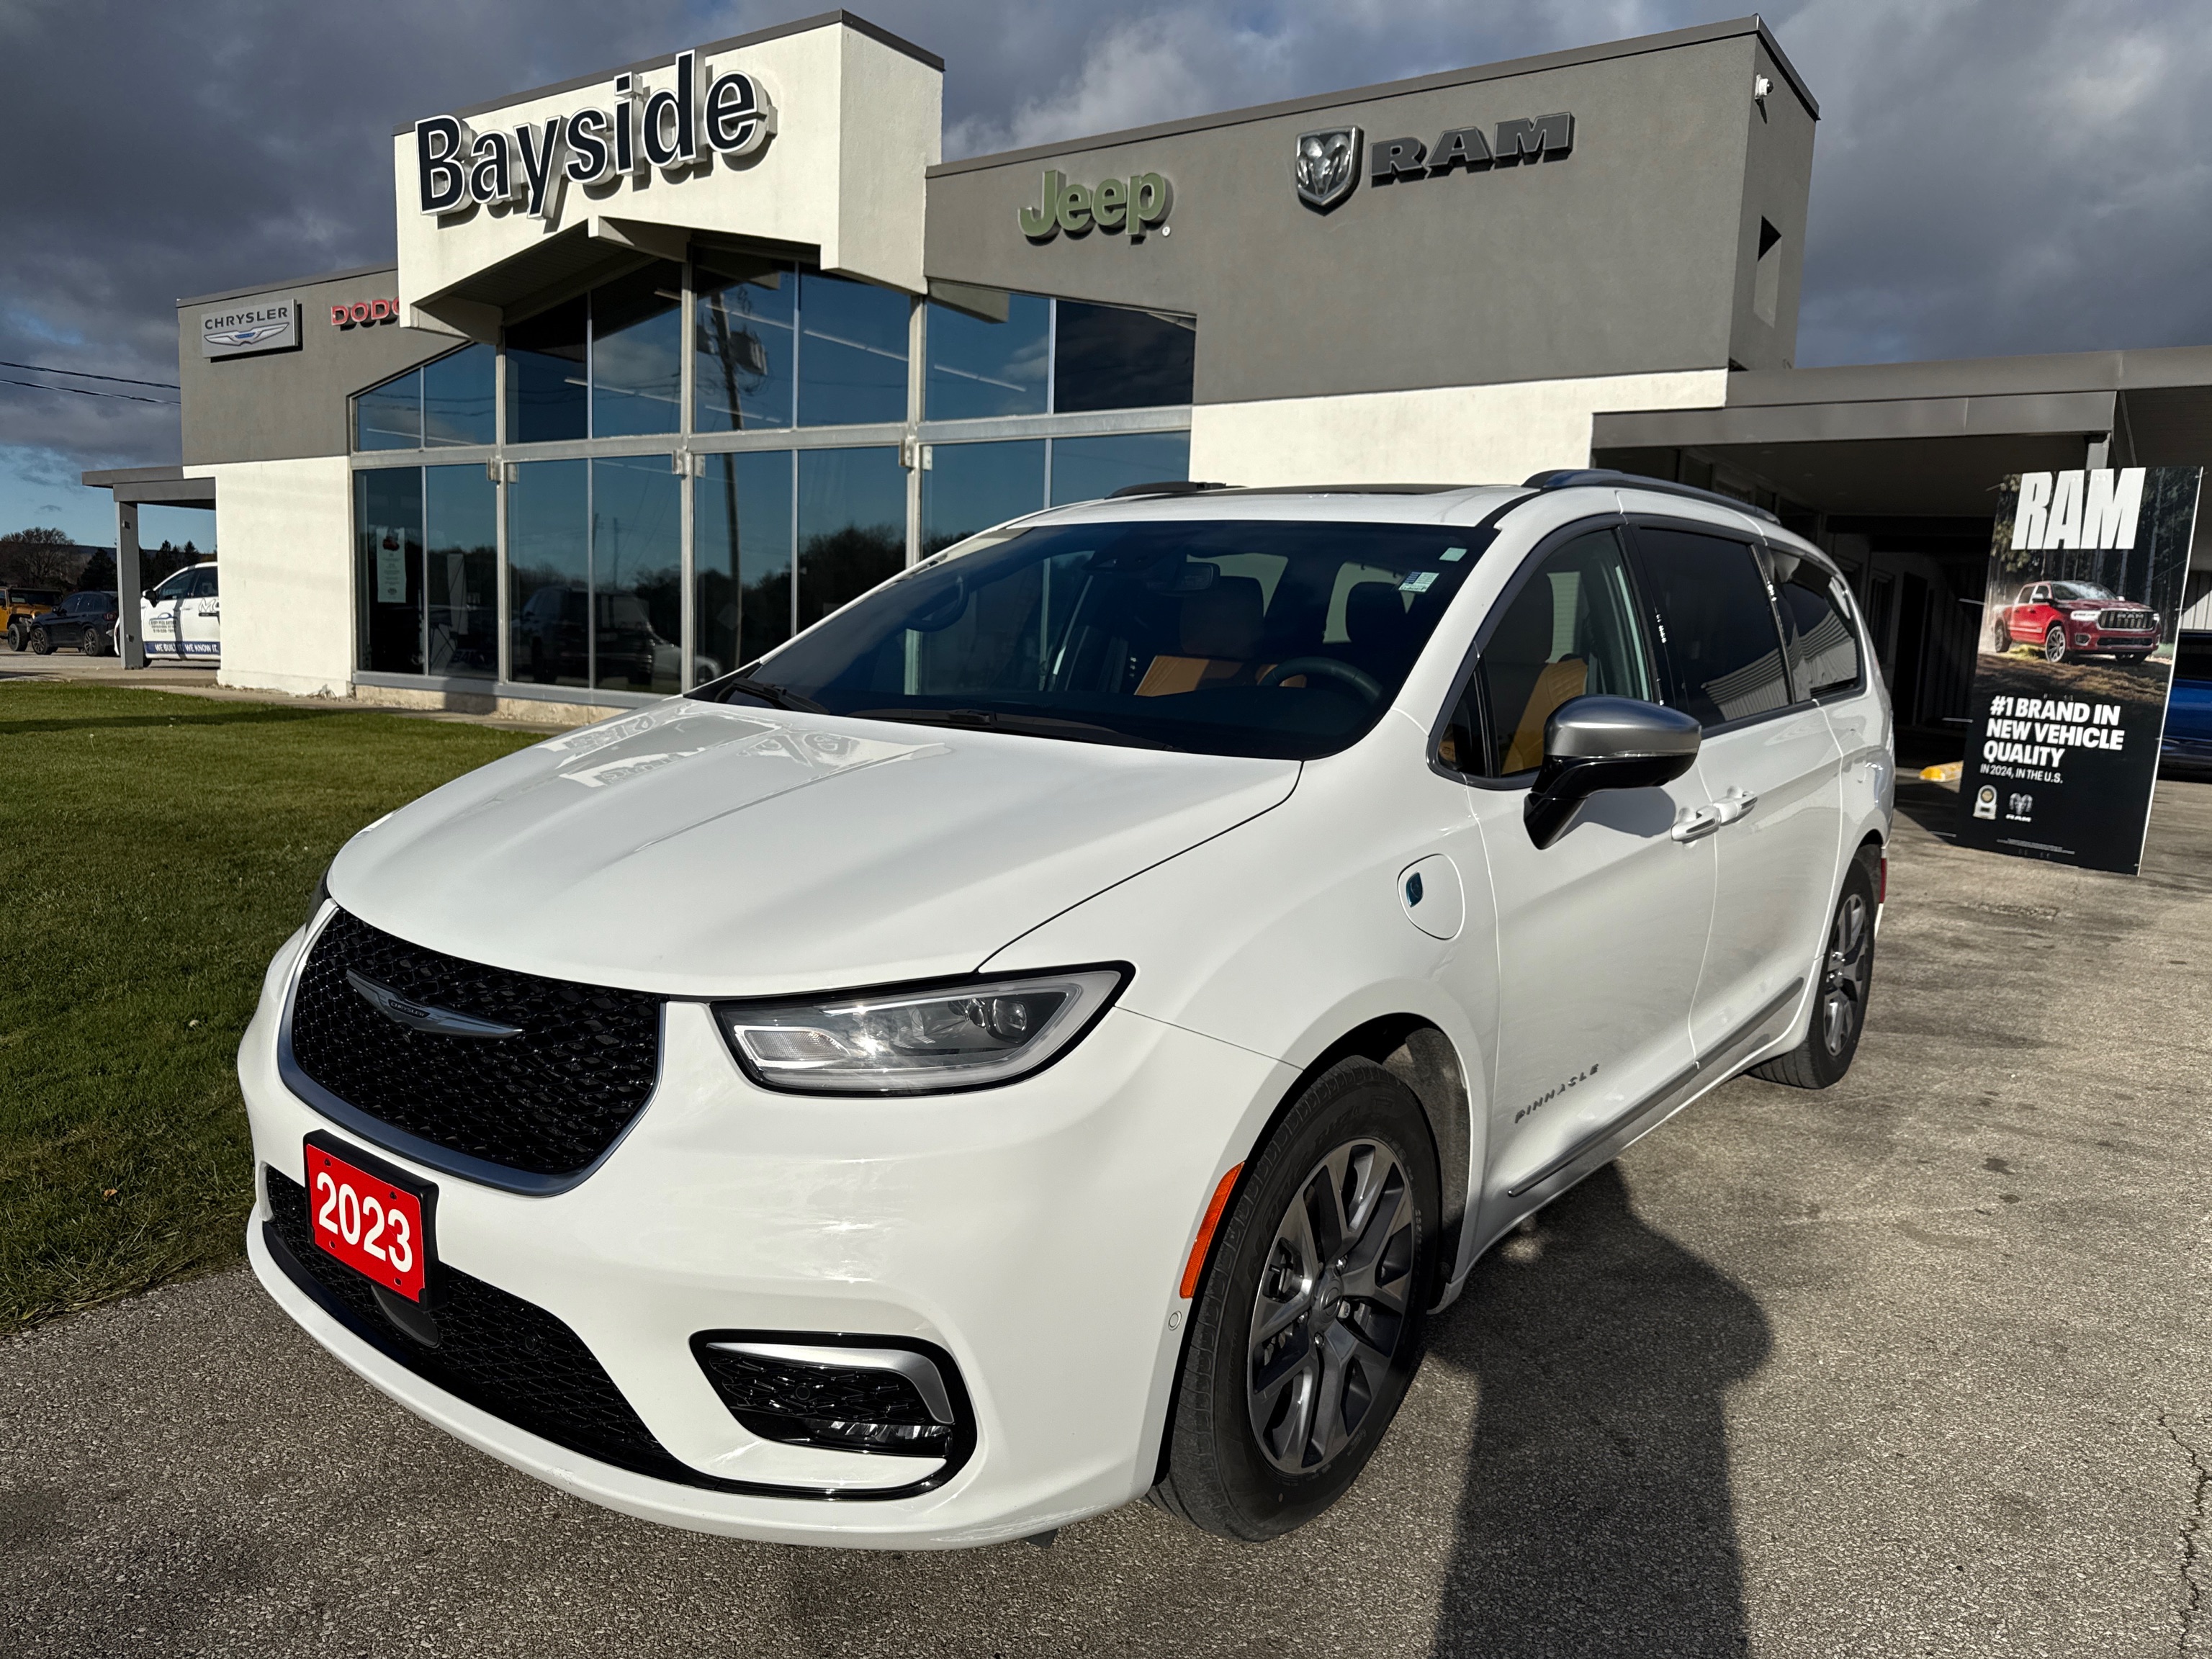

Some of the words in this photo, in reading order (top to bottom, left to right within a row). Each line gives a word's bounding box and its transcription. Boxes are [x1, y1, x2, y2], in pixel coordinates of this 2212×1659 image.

[415, 49, 763, 219] Bayside
[1370, 112, 1573, 177] RAM
[1017, 170, 1169, 238] Jeep
[204, 307, 288, 330] CHRYSLER
[2011, 467, 2146, 550] RAM
[155, 643, 163, 652] WE
[184, 643, 194, 652] WE
[194, 643, 211, 653] KNOW
[1990, 695, 2014, 716] #1
[2015, 698, 2090, 723] BRAND
[2092, 703, 2121, 726] IN
[1986, 717, 2032, 741] NEW
[2034, 721, 2126, 751] VEHICLE
[1983, 739, 2066, 768] QUALITY
[1979, 763, 1990, 774] IN
[1990, 765, 2015, 780] 2024,
[2015, 768, 2026, 779] IN
[2026, 770, 2044, 781] THE
[2044, 772, 2064, 784] U.S.
[2005, 814, 2032, 823] RAM
[1514, 1063, 1599, 1124] PINNACLE
[317, 1172, 413, 1273] 2023
